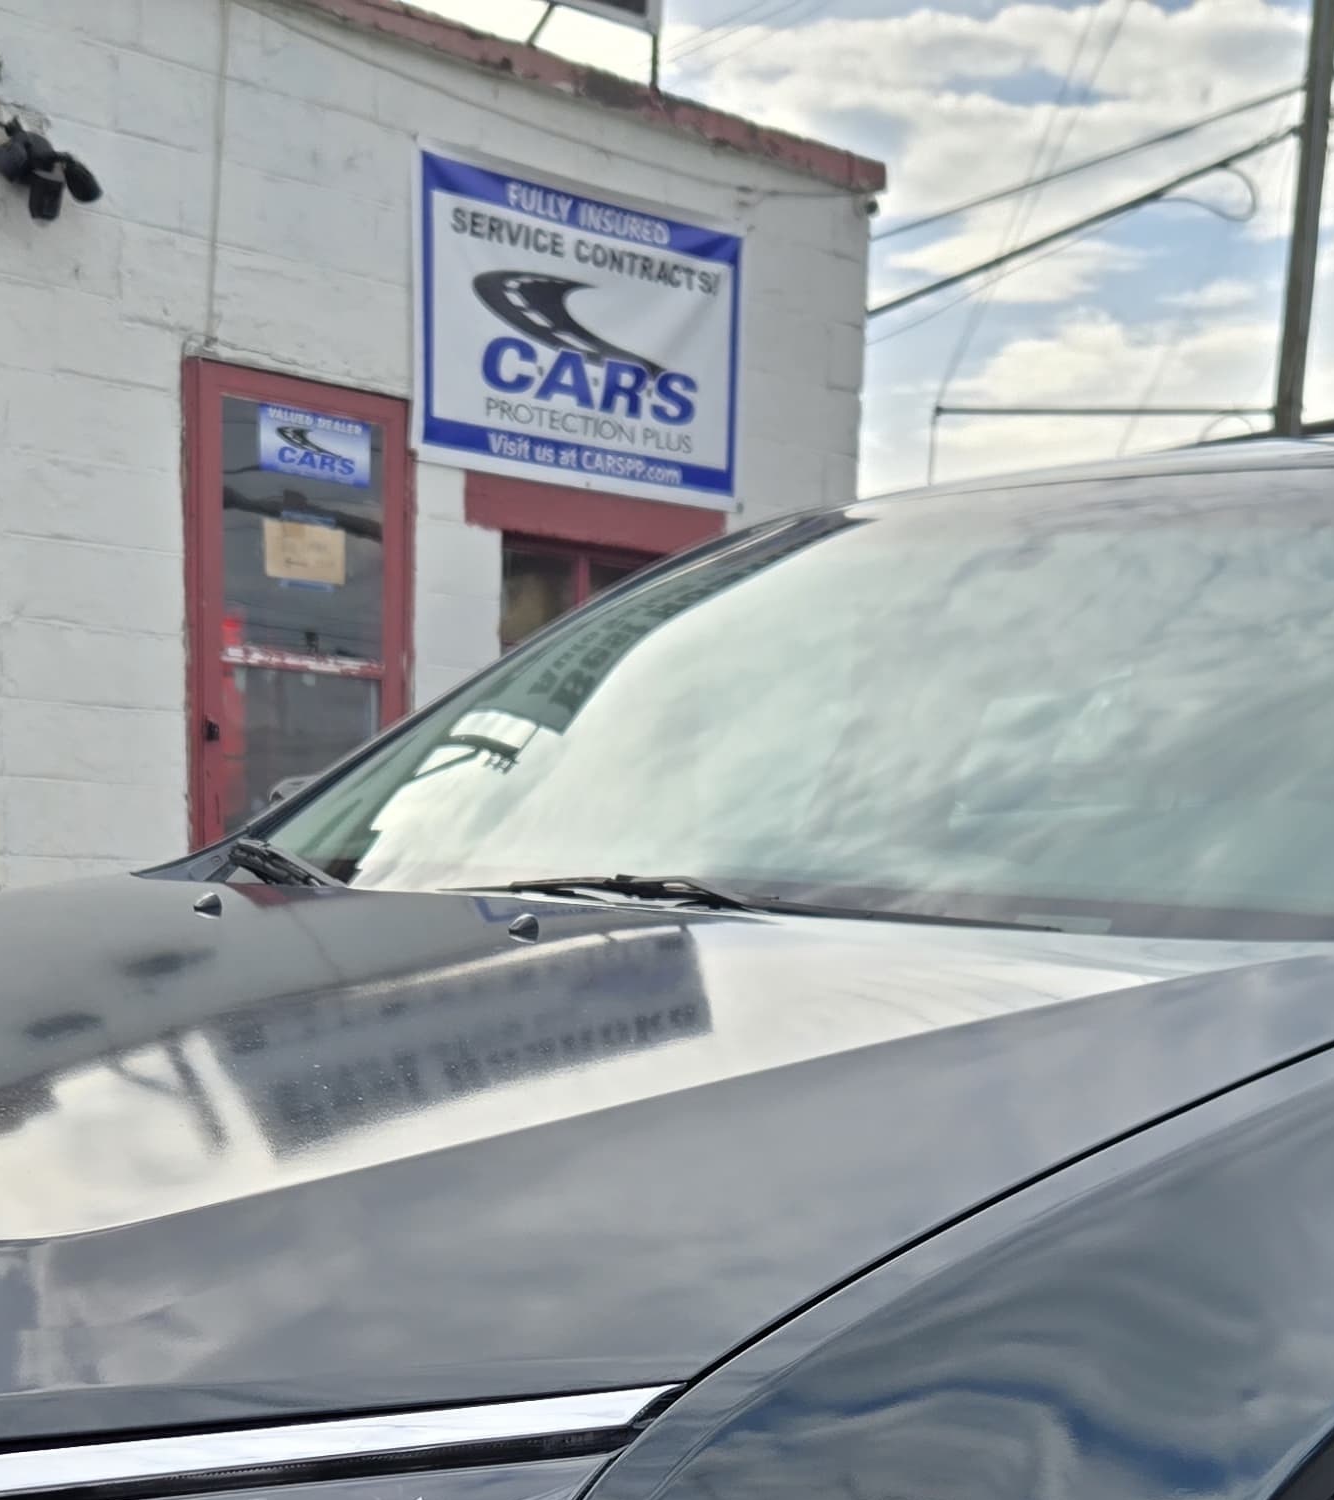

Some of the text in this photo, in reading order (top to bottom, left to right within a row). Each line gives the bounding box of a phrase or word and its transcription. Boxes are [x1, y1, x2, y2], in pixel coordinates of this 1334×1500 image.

[505, 182, 671, 245] FULLY INSURED
[450, 208, 722, 296] SERVICE CONTRACTS!
[268, 407, 363, 436] VALUED DEALER
[484, 397, 692, 454] PROTECTION PLUS
[278, 445, 356, 476] CARS
[487, 432, 683, 486] Visit us at CARSPP.com
